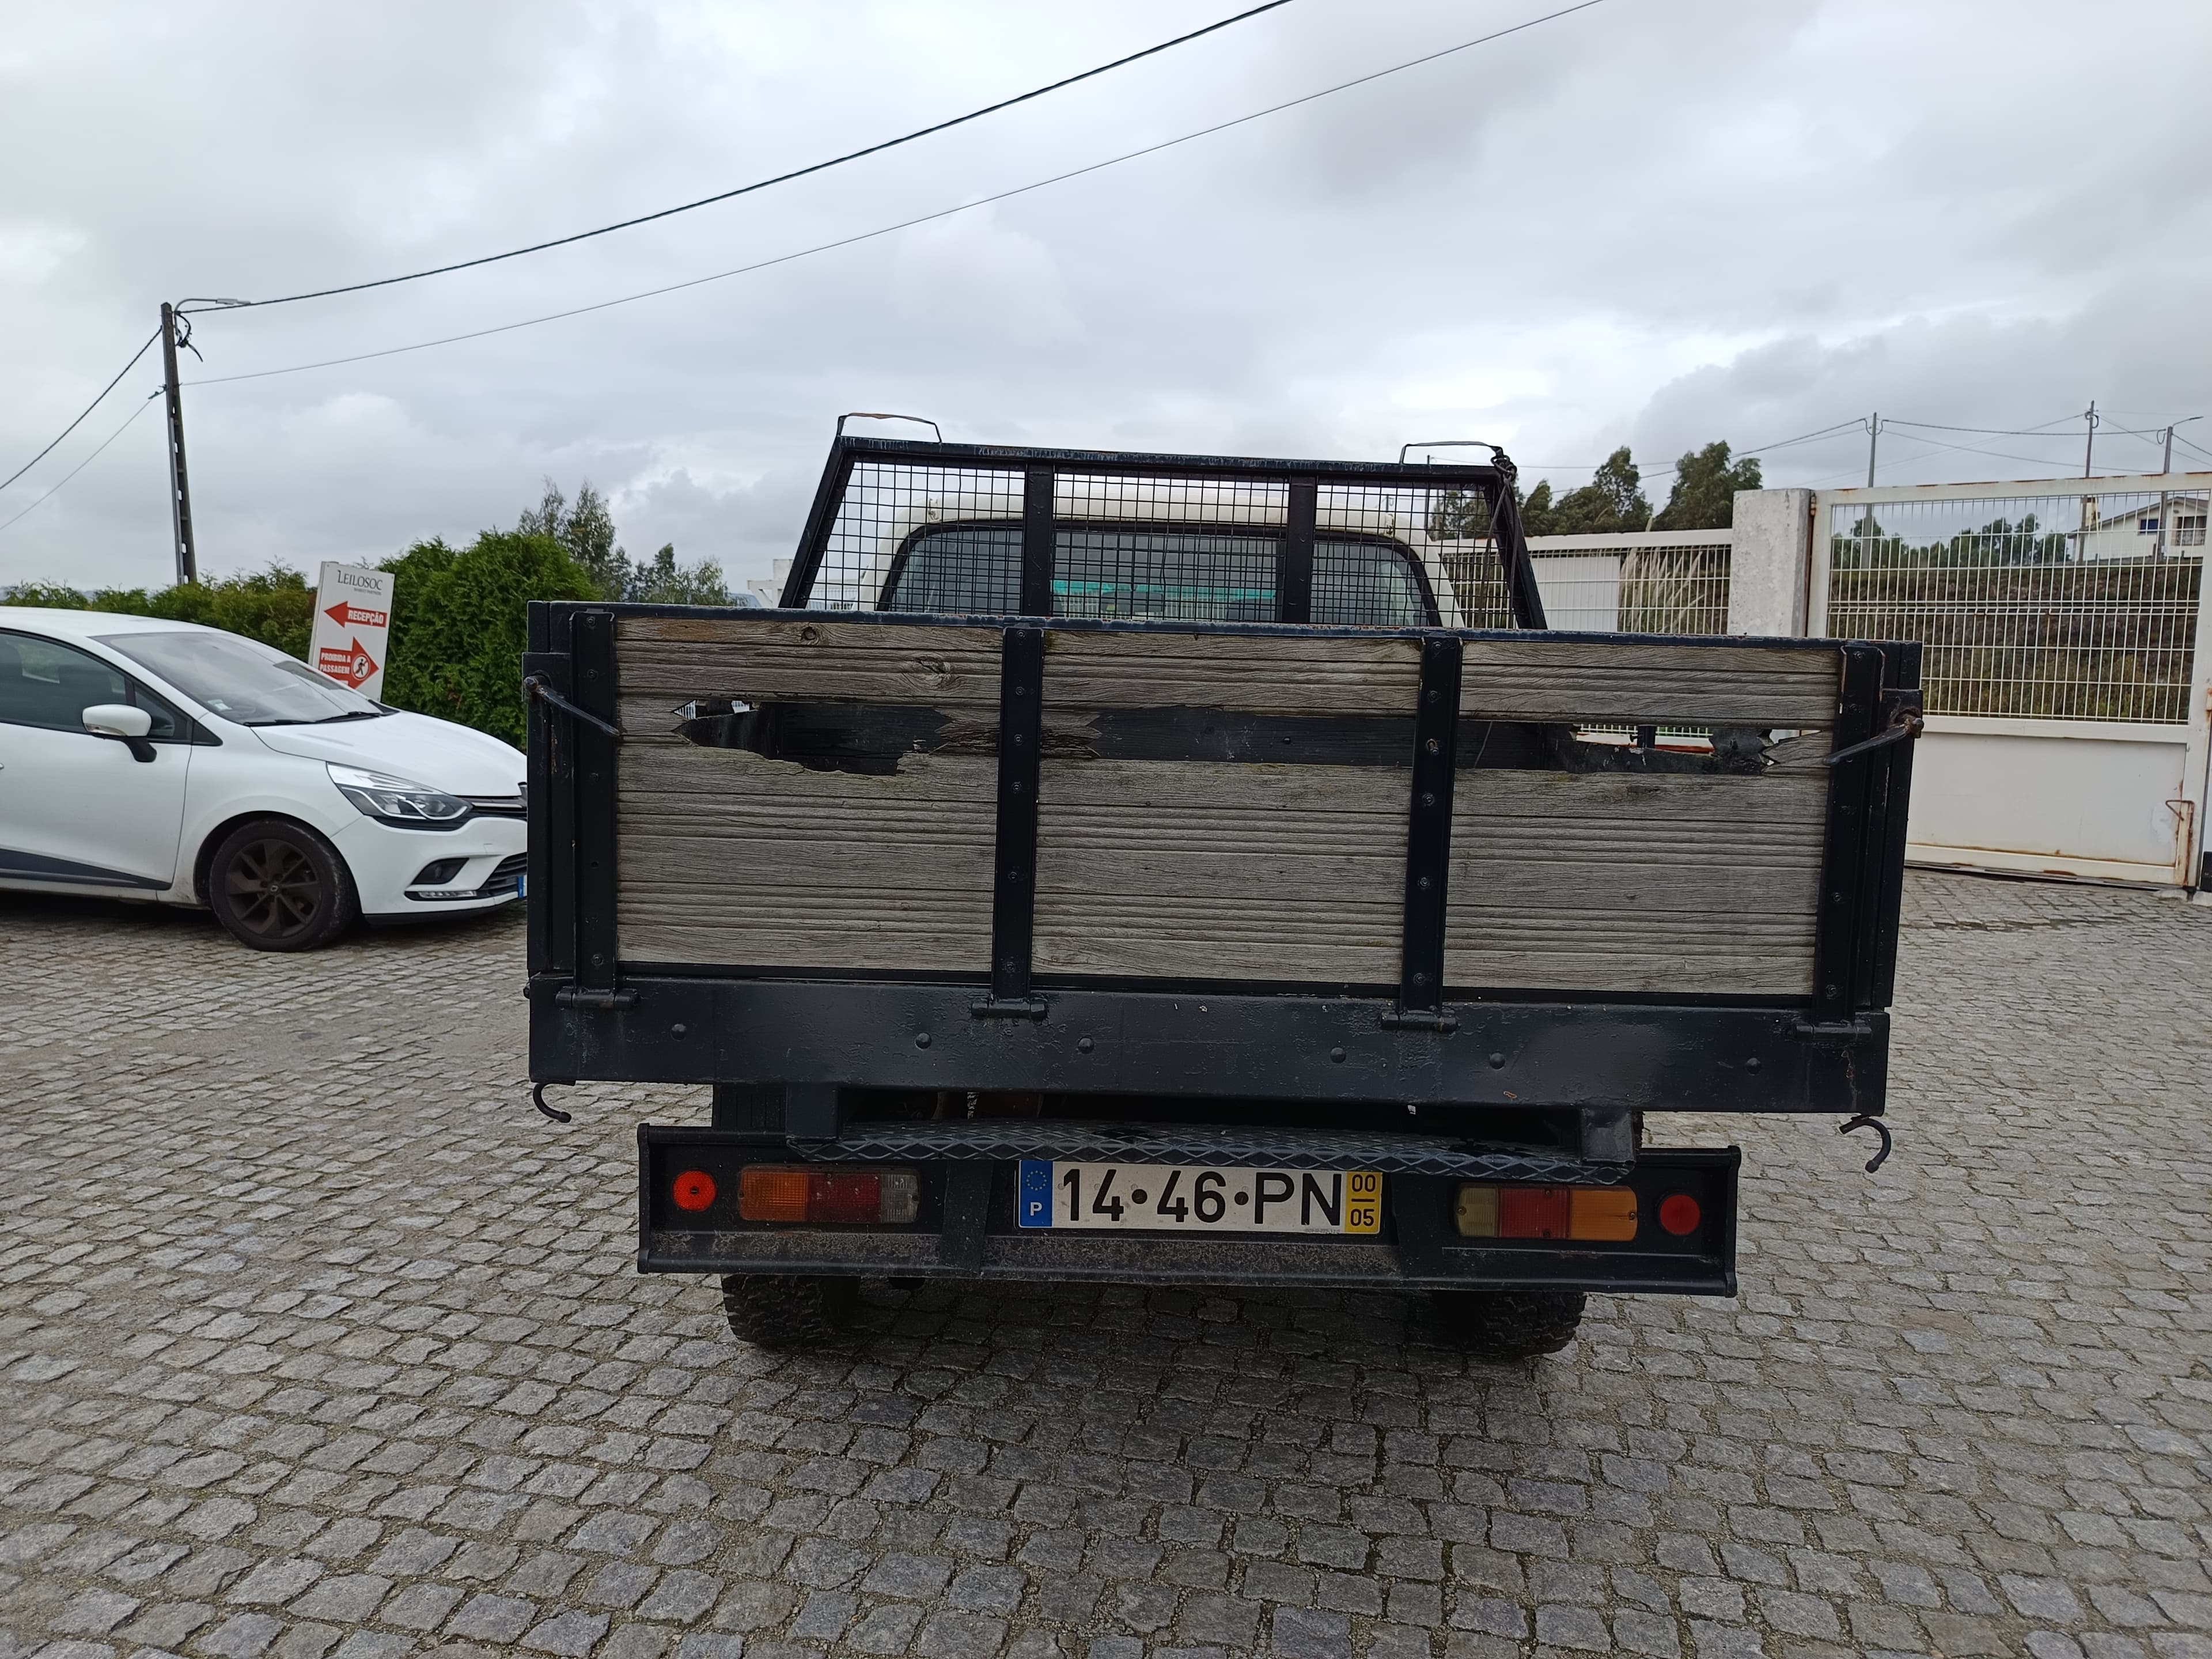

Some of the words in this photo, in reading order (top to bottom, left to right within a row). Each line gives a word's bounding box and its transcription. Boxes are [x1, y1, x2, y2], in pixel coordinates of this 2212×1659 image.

[338, 569, 382, 590] LEILOSOC
[348, 609, 384, 626] RECEPÇÃO
[321, 652, 346, 662] PROIBIDA
[347, 655, 351, 663] A
[320, 664, 350, 675] PASSAGEM
[1351, 1174, 1376, 1192] 00
[1030, 1202, 1043, 1217] P
[1350, 1209, 1375, 1226] 05
